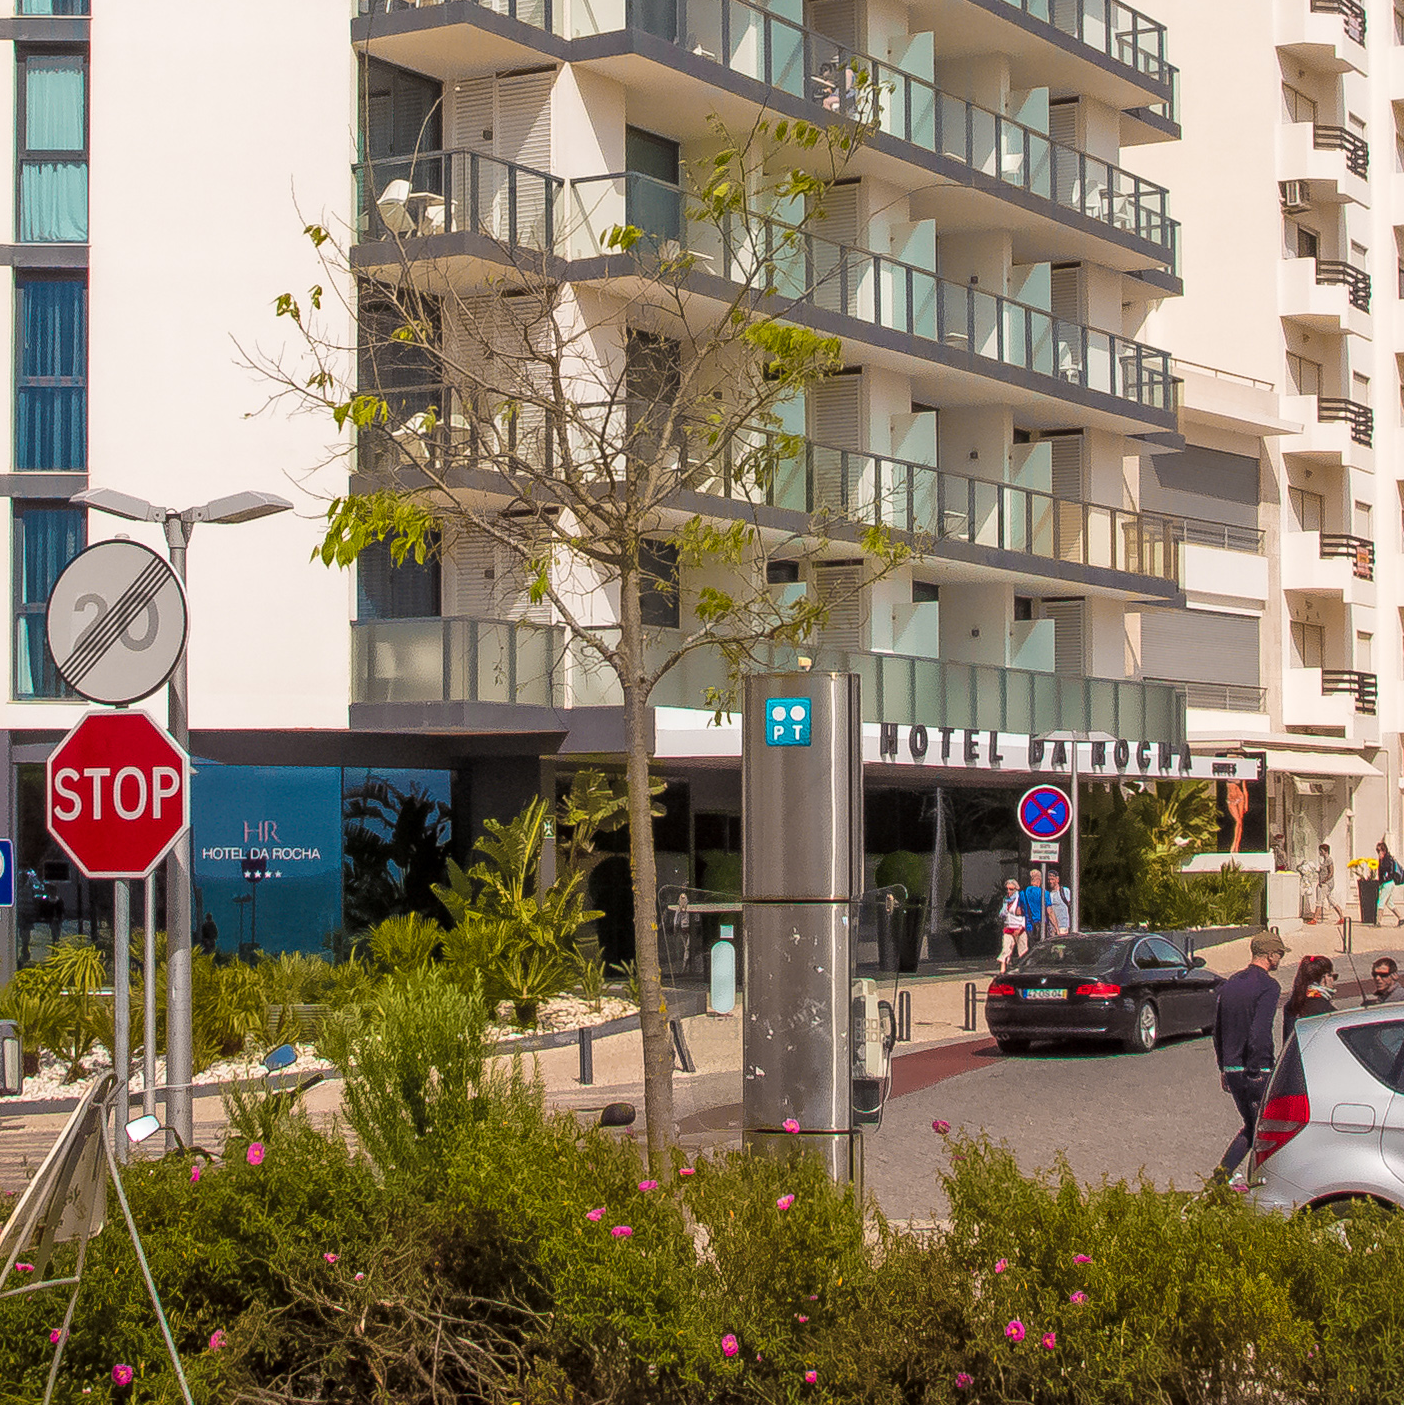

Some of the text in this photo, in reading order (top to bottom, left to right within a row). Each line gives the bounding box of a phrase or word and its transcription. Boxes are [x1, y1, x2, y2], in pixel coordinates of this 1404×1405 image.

[72, 593, 159, 651] 20
[880, 722, 1003, 761] HOTEL
[1092, 738, 1193, 770] ROCHA
[54, 766, 180, 822] STOP
[202, 847, 321, 860] HOTEL DA ROCHA
[242, 820, 281, 844] HR
